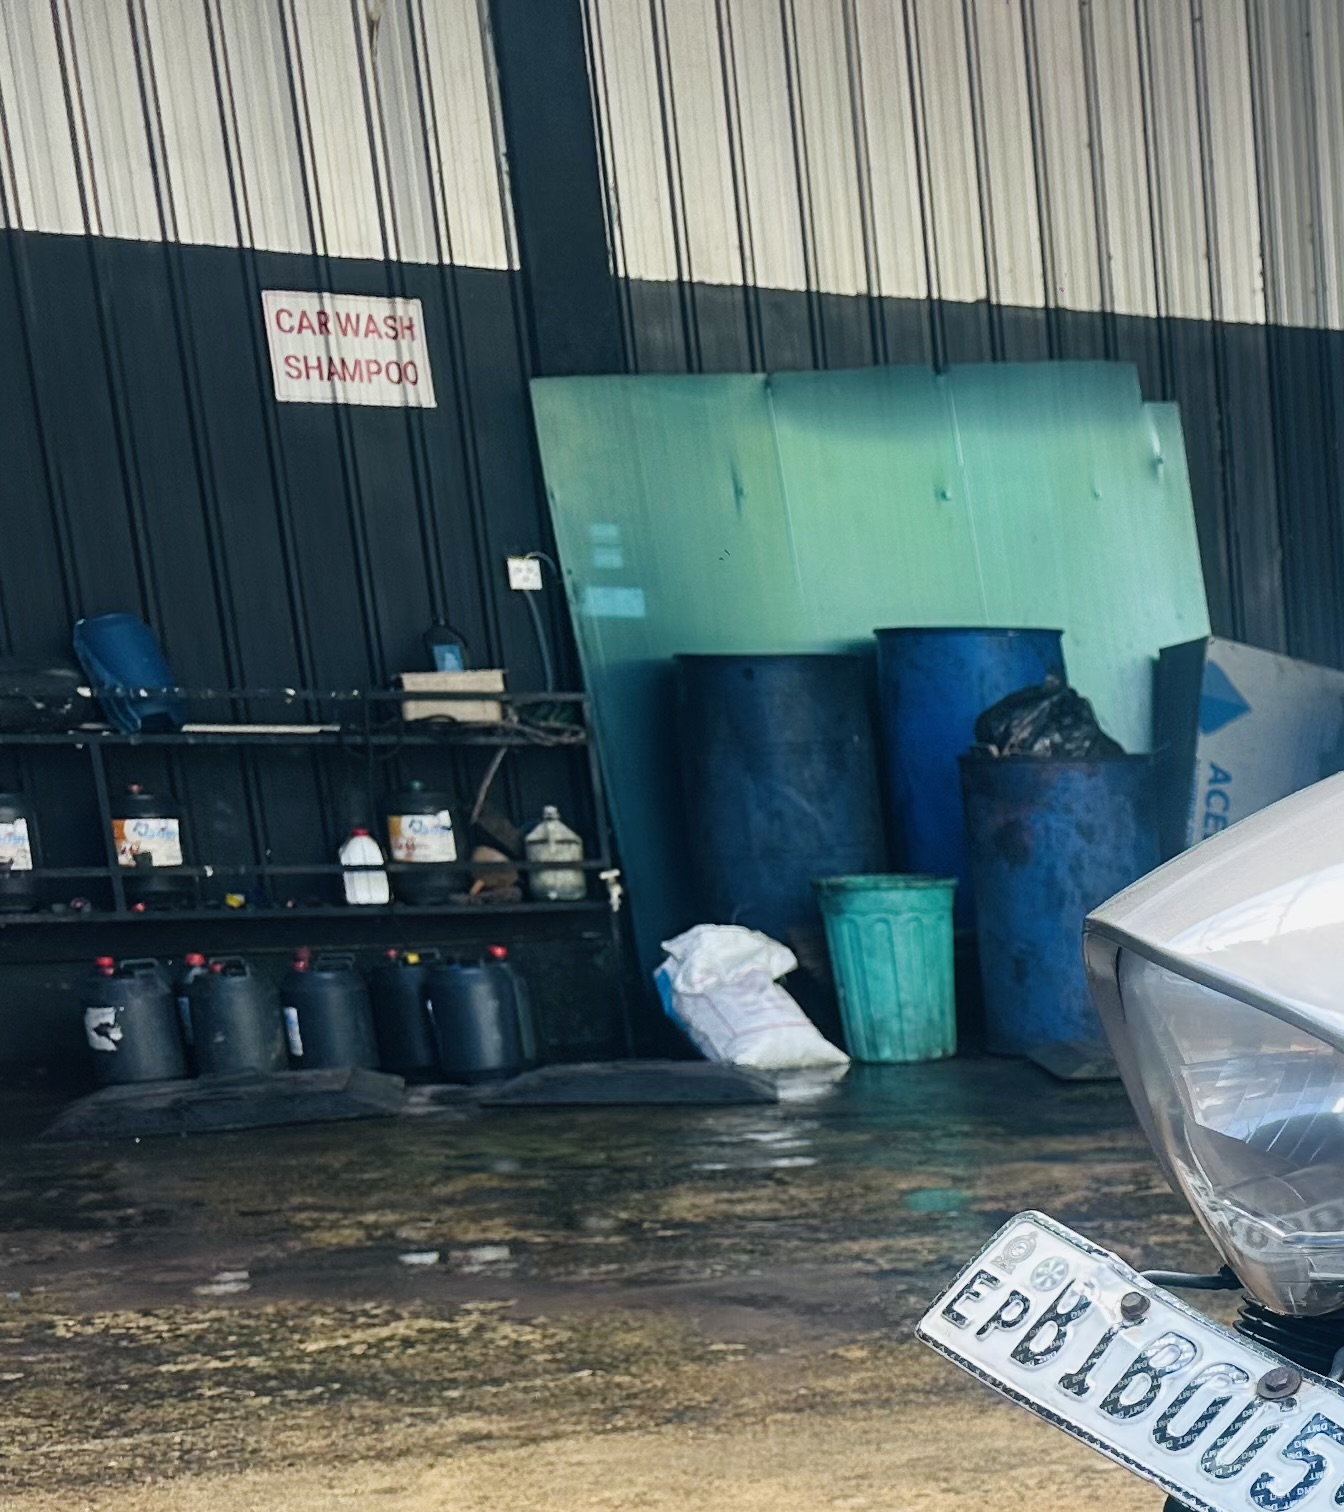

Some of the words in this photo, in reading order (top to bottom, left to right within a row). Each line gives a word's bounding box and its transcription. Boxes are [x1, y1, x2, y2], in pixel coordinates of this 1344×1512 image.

[275, 308, 332, 335] CAR
[335, 311, 416, 341] WASH
[283, 355, 419, 386] SHAMPOO
[940, 1268, 1032, 1337] EP
